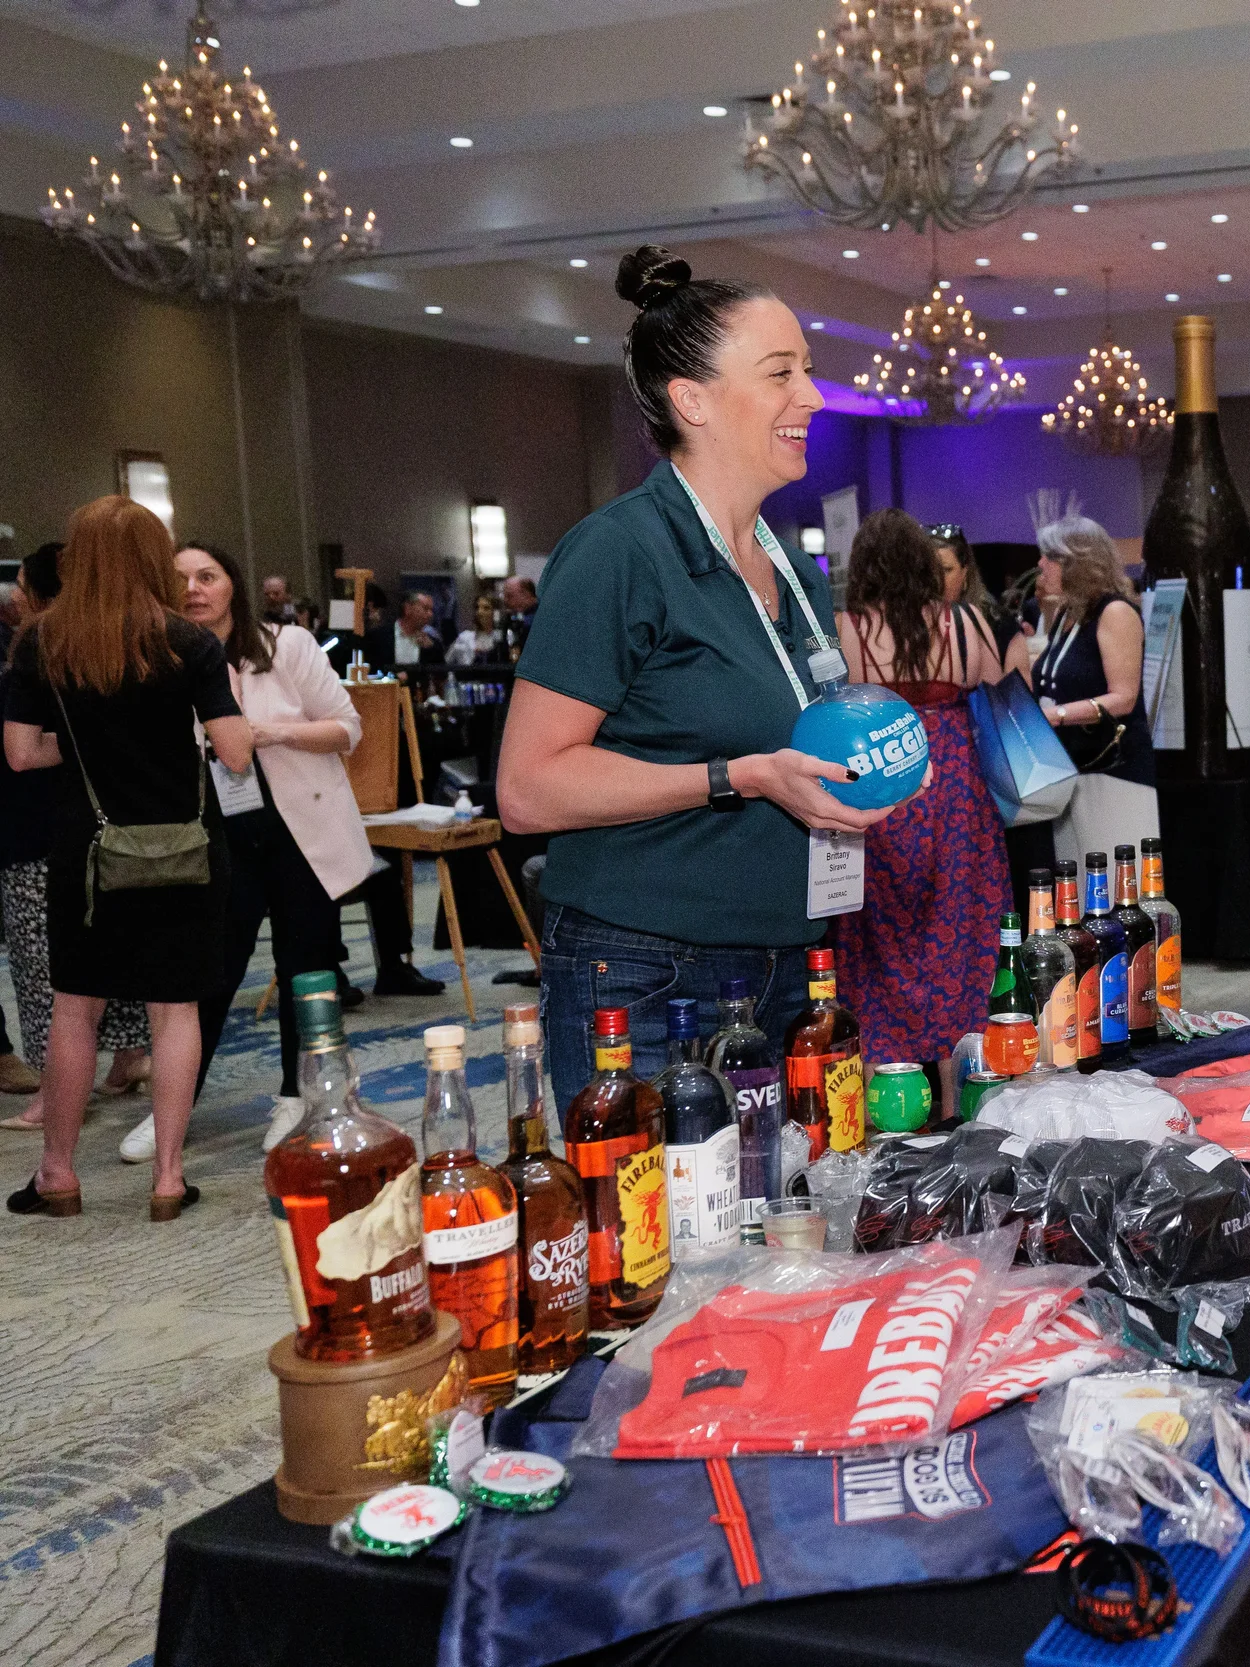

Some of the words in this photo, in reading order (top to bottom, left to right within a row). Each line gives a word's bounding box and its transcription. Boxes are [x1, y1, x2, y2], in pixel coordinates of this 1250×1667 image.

[783, 566, 806, 601] Littler
[826, 851, 850, 861] Brittany
[829, 863, 847, 872] Siravo
[814, 878, 830, 886] National
[830, 875, 845, 884] Account
[845, 873, 861, 881] Manager
[827, 890, 848, 900] SAZERAC
